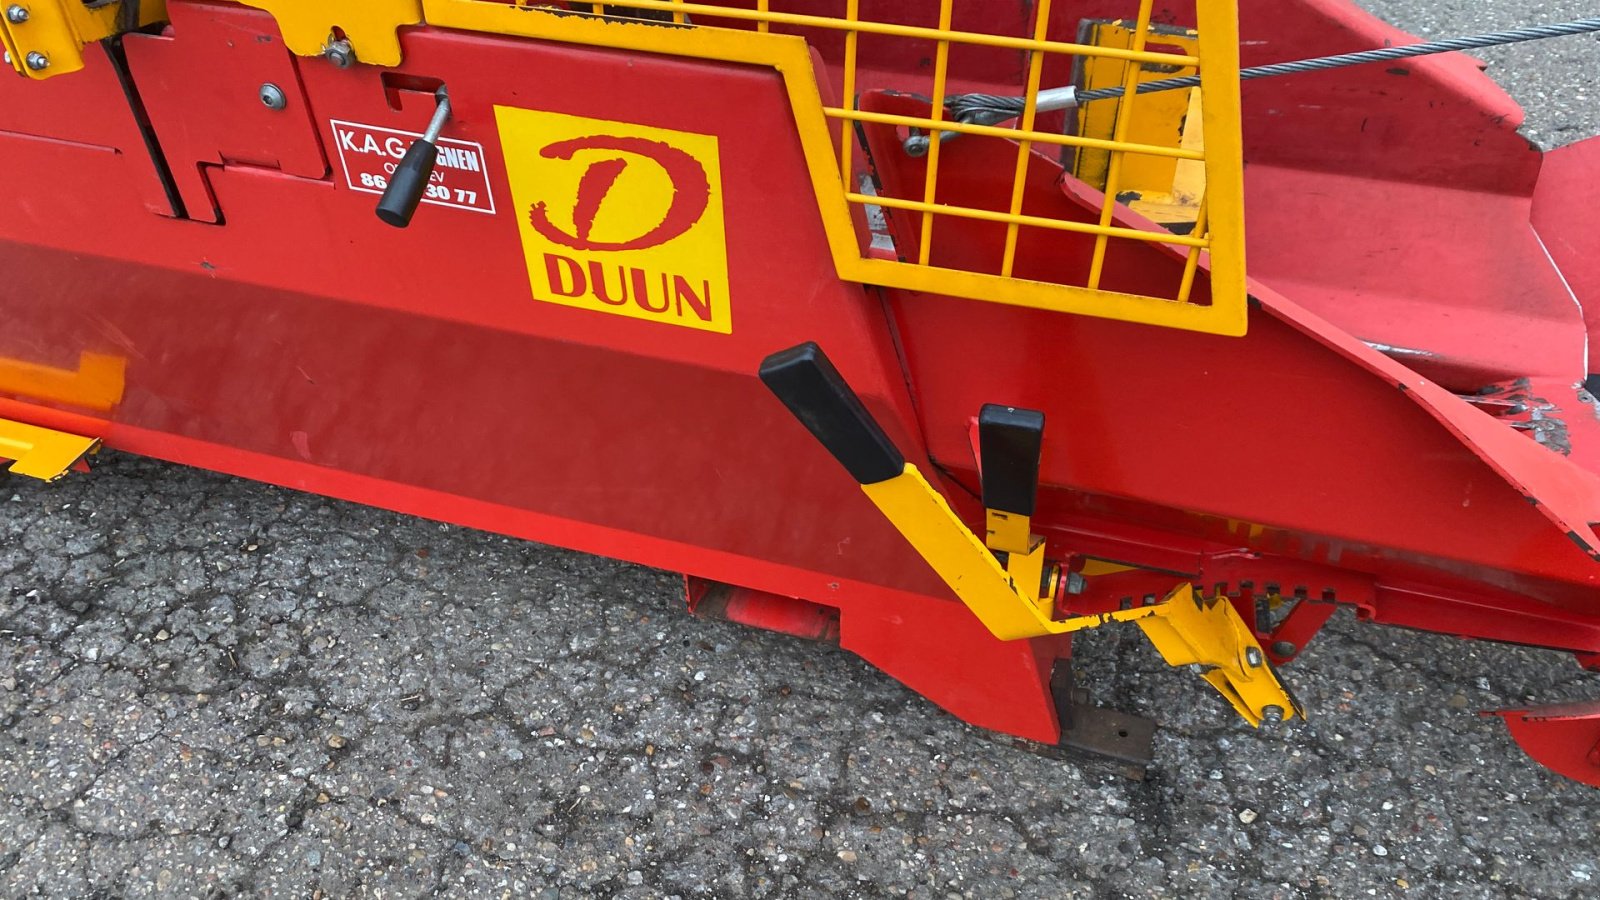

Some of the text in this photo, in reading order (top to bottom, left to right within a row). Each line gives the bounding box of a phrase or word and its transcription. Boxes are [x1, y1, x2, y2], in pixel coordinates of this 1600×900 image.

[360, 172, 388, 189] 86
[425, 183, 451, 200] 30
[454, 188, 477, 205] 77
[543, 252, 712, 322] DUUN
